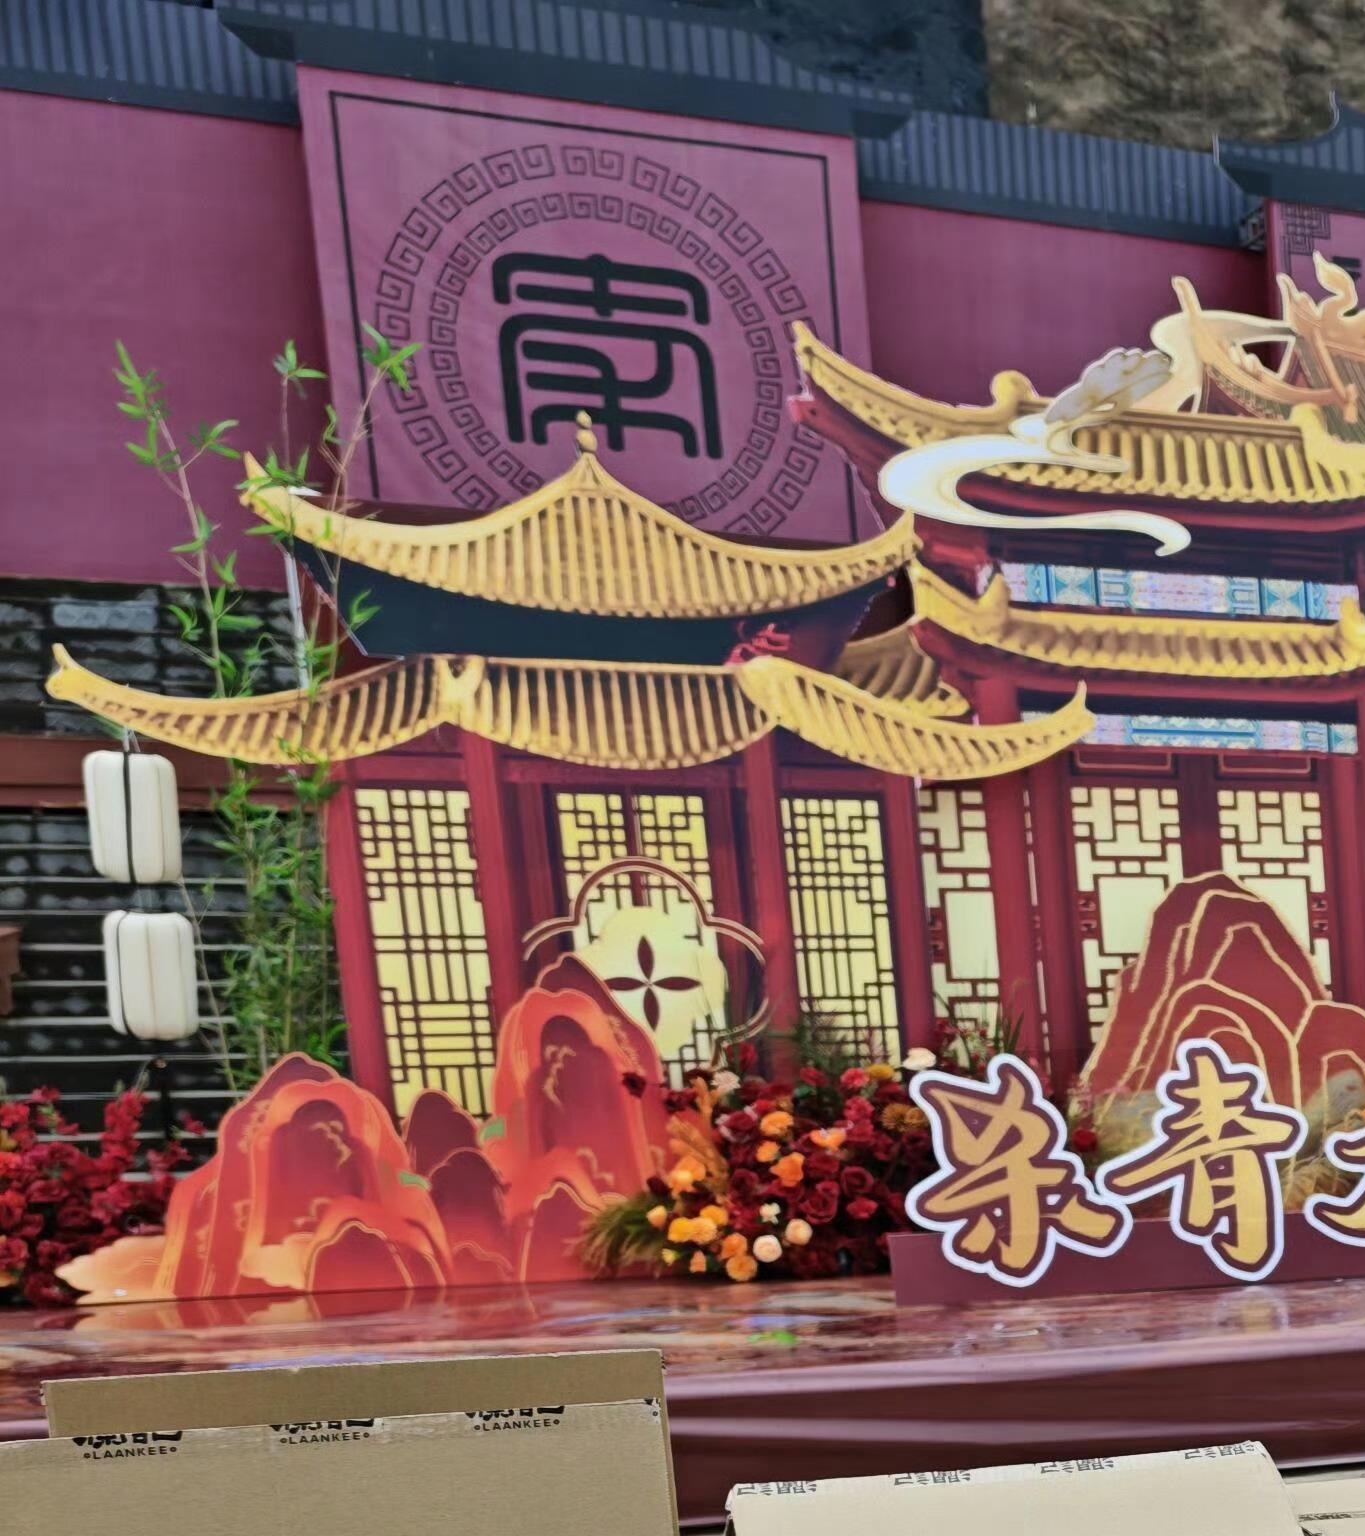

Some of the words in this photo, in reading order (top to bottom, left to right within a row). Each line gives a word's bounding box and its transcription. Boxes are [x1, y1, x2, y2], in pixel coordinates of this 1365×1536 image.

[481, 1418, 554, 1433] LAANKEE
[288, 1431, 362, 1446] LAANKEE
[93, 1445, 169, 1461] LAANKEE
